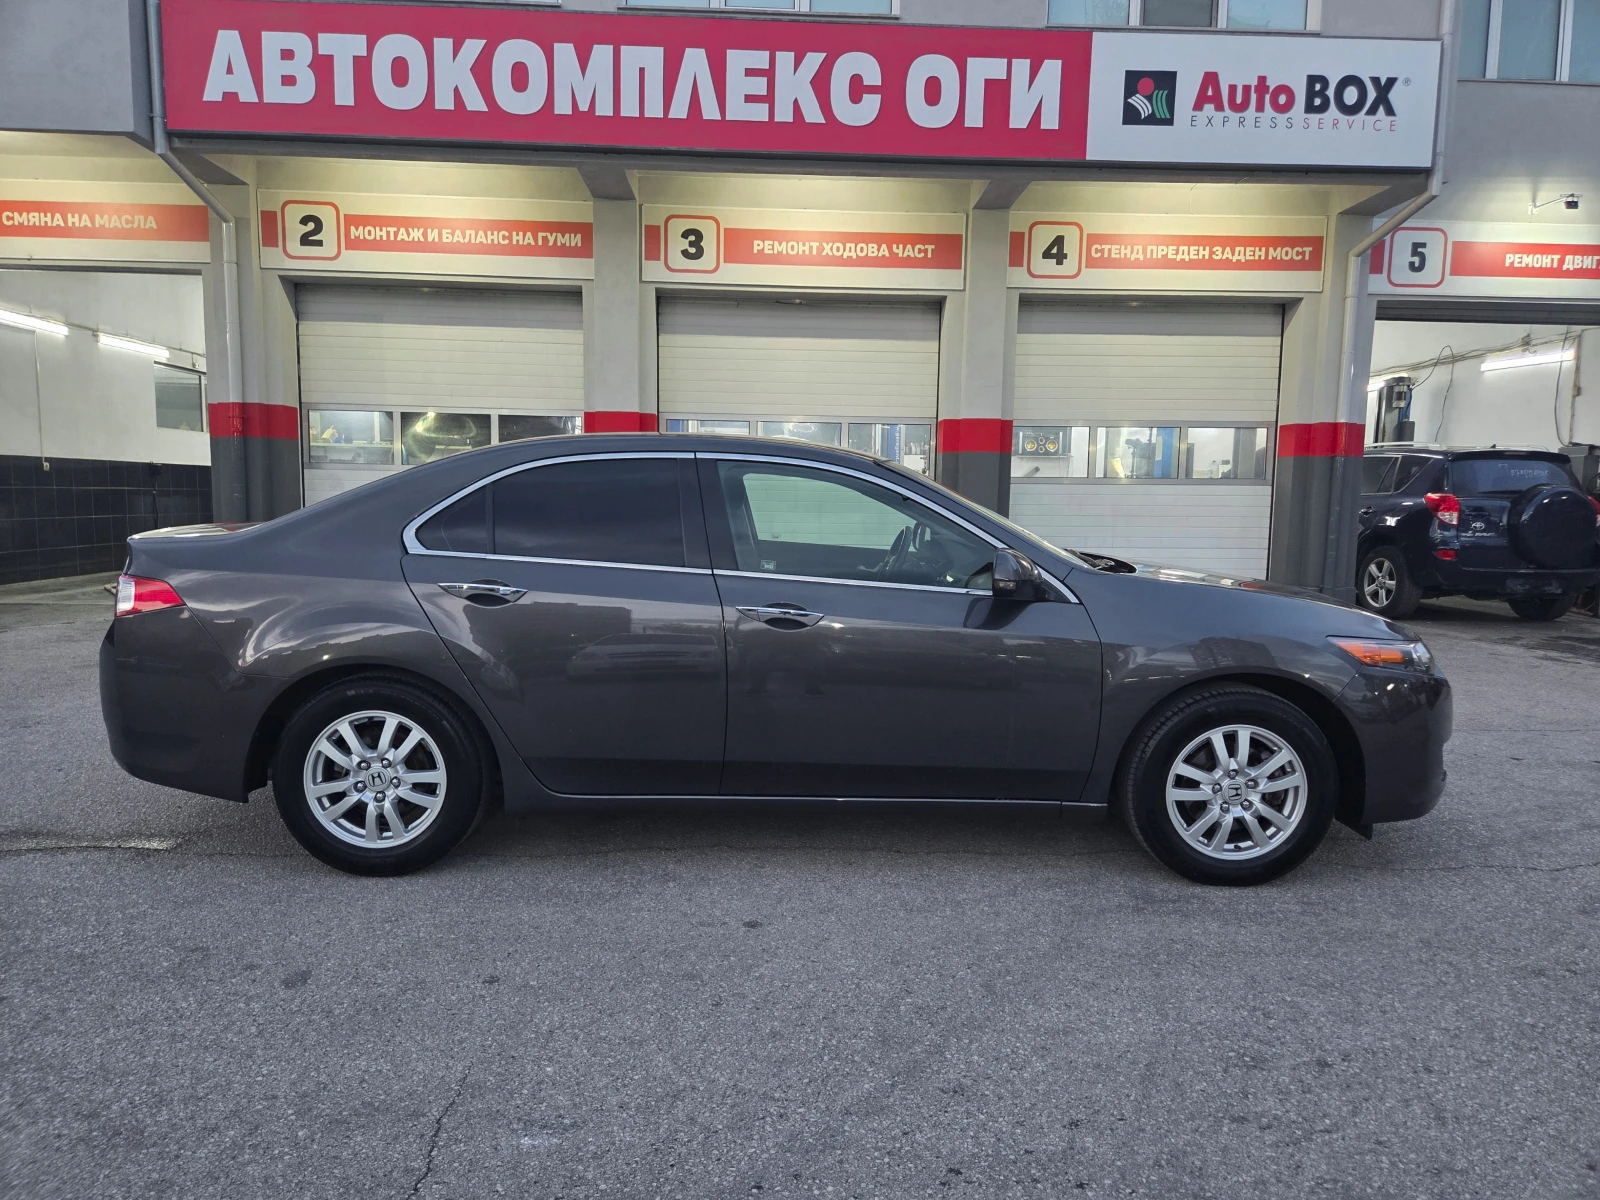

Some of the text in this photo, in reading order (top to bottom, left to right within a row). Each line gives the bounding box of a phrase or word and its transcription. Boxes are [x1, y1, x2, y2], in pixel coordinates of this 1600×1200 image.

[202, 29, 1063, 130] АВТОКОМПЛЕКС ОГИ
[1191, 71, 1399, 117] Auto BOX
[1, 211, 158, 230] СМЯНА НА МАСЛА
[299, 214, 324, 247] 2
[350, 225, 582, 247] МОНТАЖ И БАЛАНС НА ГУМИ
[680, 227, 705, 260] 3
[753, 239, 936, 259] РЕМОНТ ХОДОВА ЧАСТ
[1041, 234, 1069, 266] 4
[1090, 244, 1313, 263] СТЕНД ПРЕДЕН ЗАДЕН МОСТ
[1407, 242, 1426, 273] 5
[1504, 253, 1600, 271] РЕМОНТ ДВИГ
